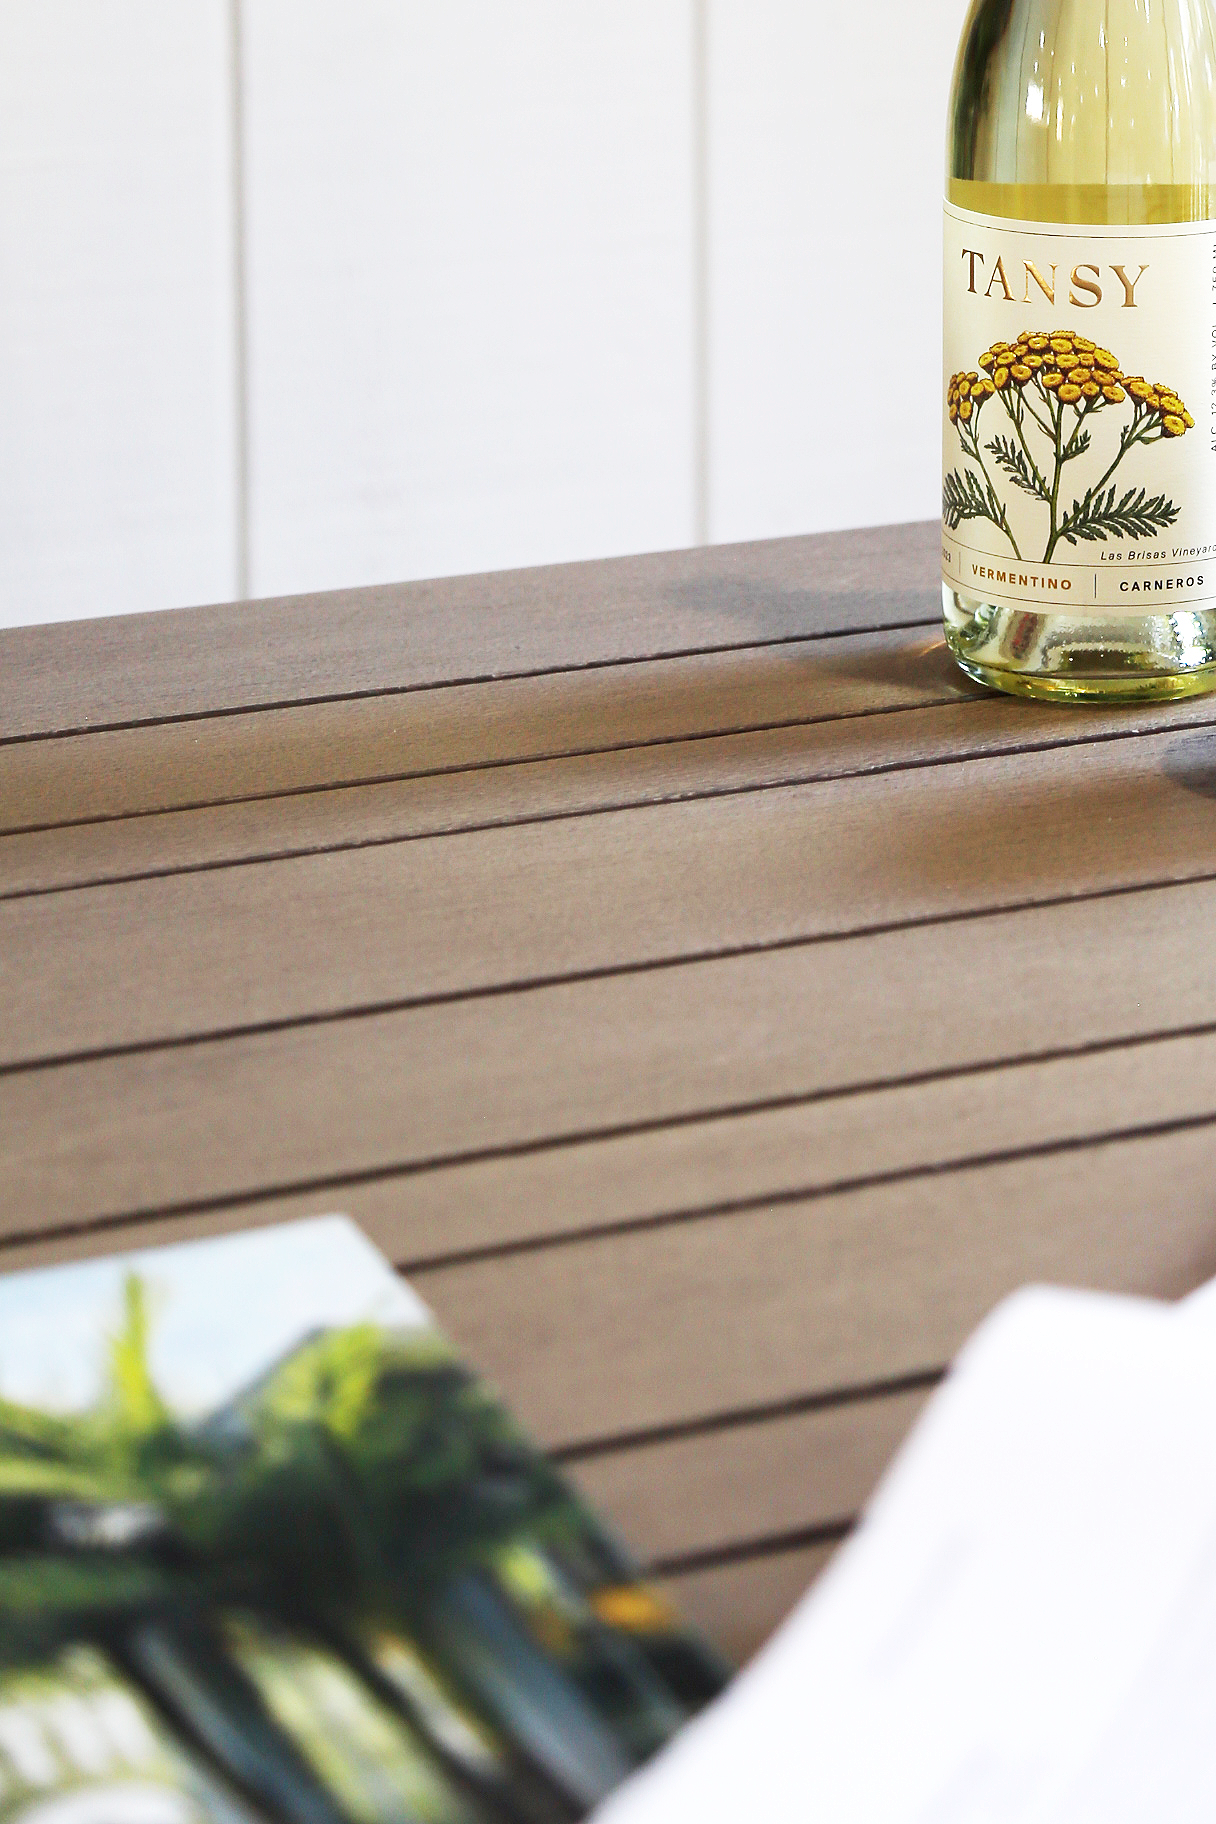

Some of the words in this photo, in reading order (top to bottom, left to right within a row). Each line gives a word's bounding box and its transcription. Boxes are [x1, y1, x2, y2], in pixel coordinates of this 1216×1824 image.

[961, 248, 1150, 308] TANSY
[1100, 551, 1123, 561] Las
[1127, 550, 1167, 561] Brisas
[971, 563, 1073, 591] VERMENTINO
[1119, 575, 1205, 592] CARNEROS
